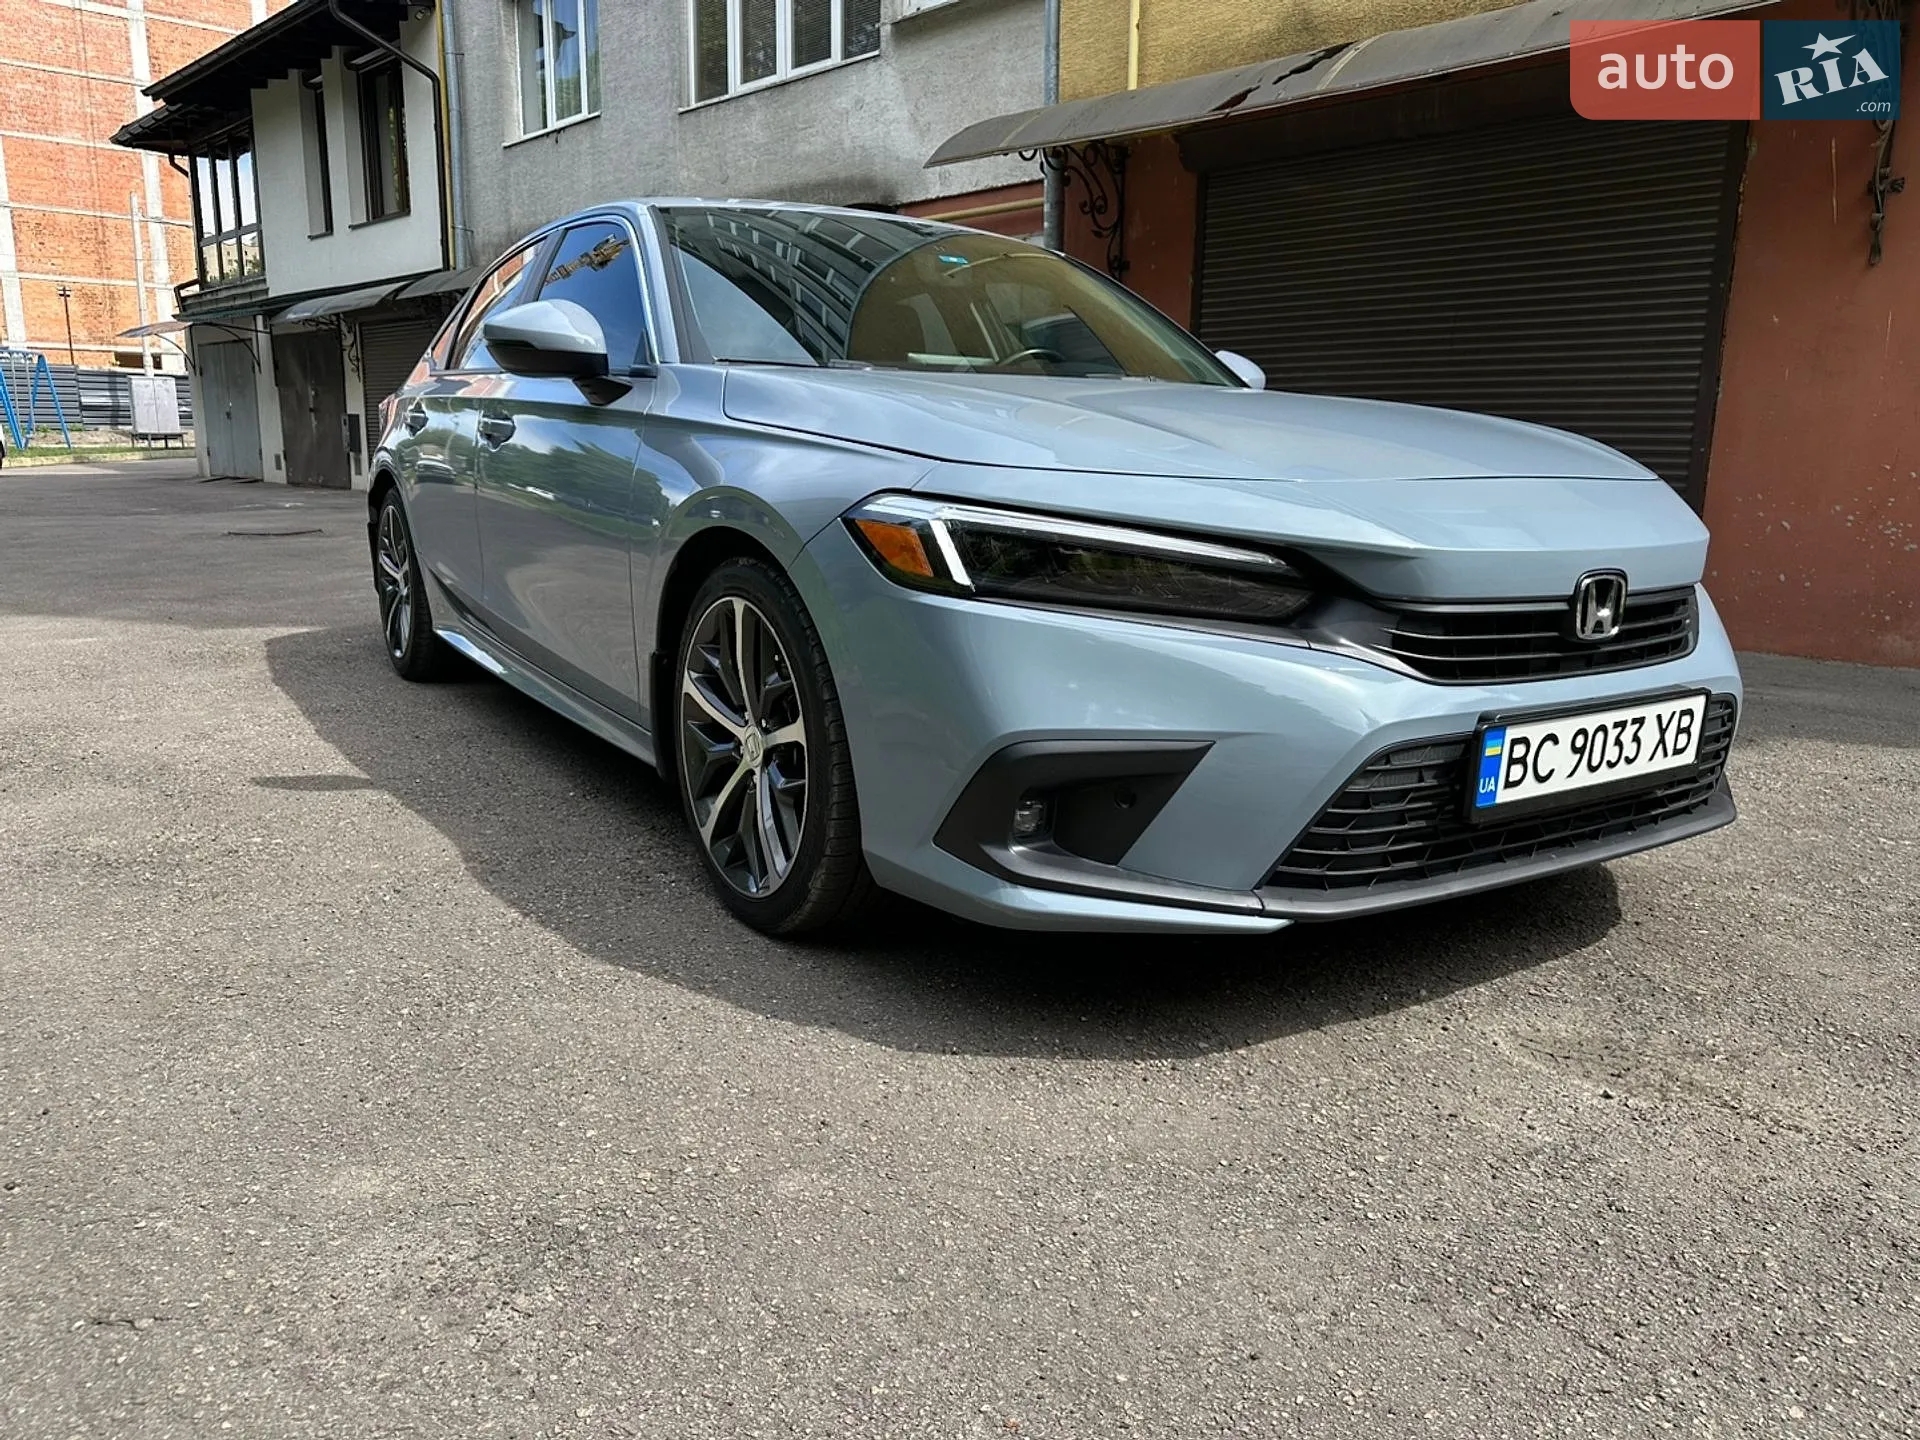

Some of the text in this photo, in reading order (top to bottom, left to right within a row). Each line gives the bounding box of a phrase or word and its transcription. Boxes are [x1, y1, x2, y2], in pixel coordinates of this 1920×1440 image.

[1503, 708, 1694, 789] BC 9033 XB
[1479, 778, 1496, 793] UA
